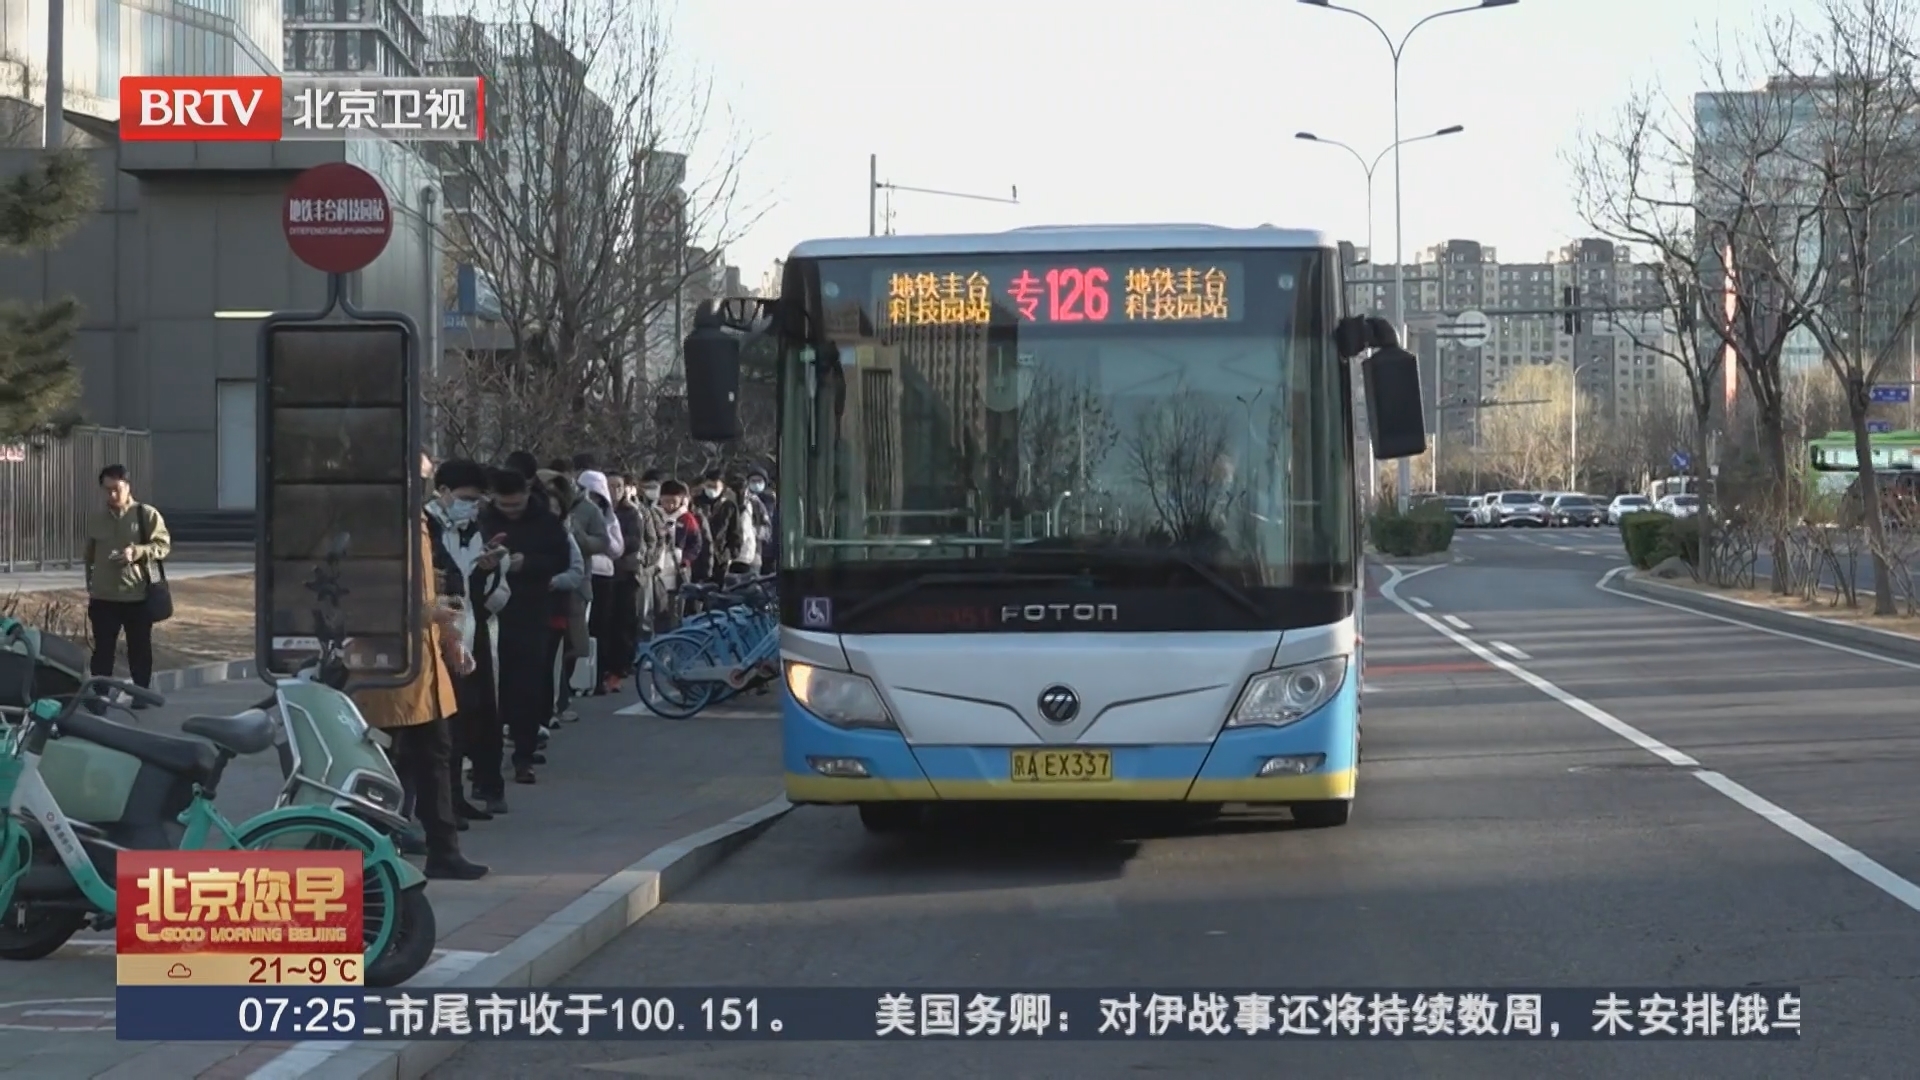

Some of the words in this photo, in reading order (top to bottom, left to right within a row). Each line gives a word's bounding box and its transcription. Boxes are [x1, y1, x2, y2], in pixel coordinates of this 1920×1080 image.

[289, 198, 385, 222] 地铁丰台科技园站
[888, 271, 990, 300] 地铁丰台
[1124, 266, 1228, 296] 地铁丰台
[1007, 267, 1110, 322] 专126
[1125, 294, 1228, 320] 科技园站
[888, 299, 990, 325] 科技园站
[1001, 604, 1118, 622] FOTON
